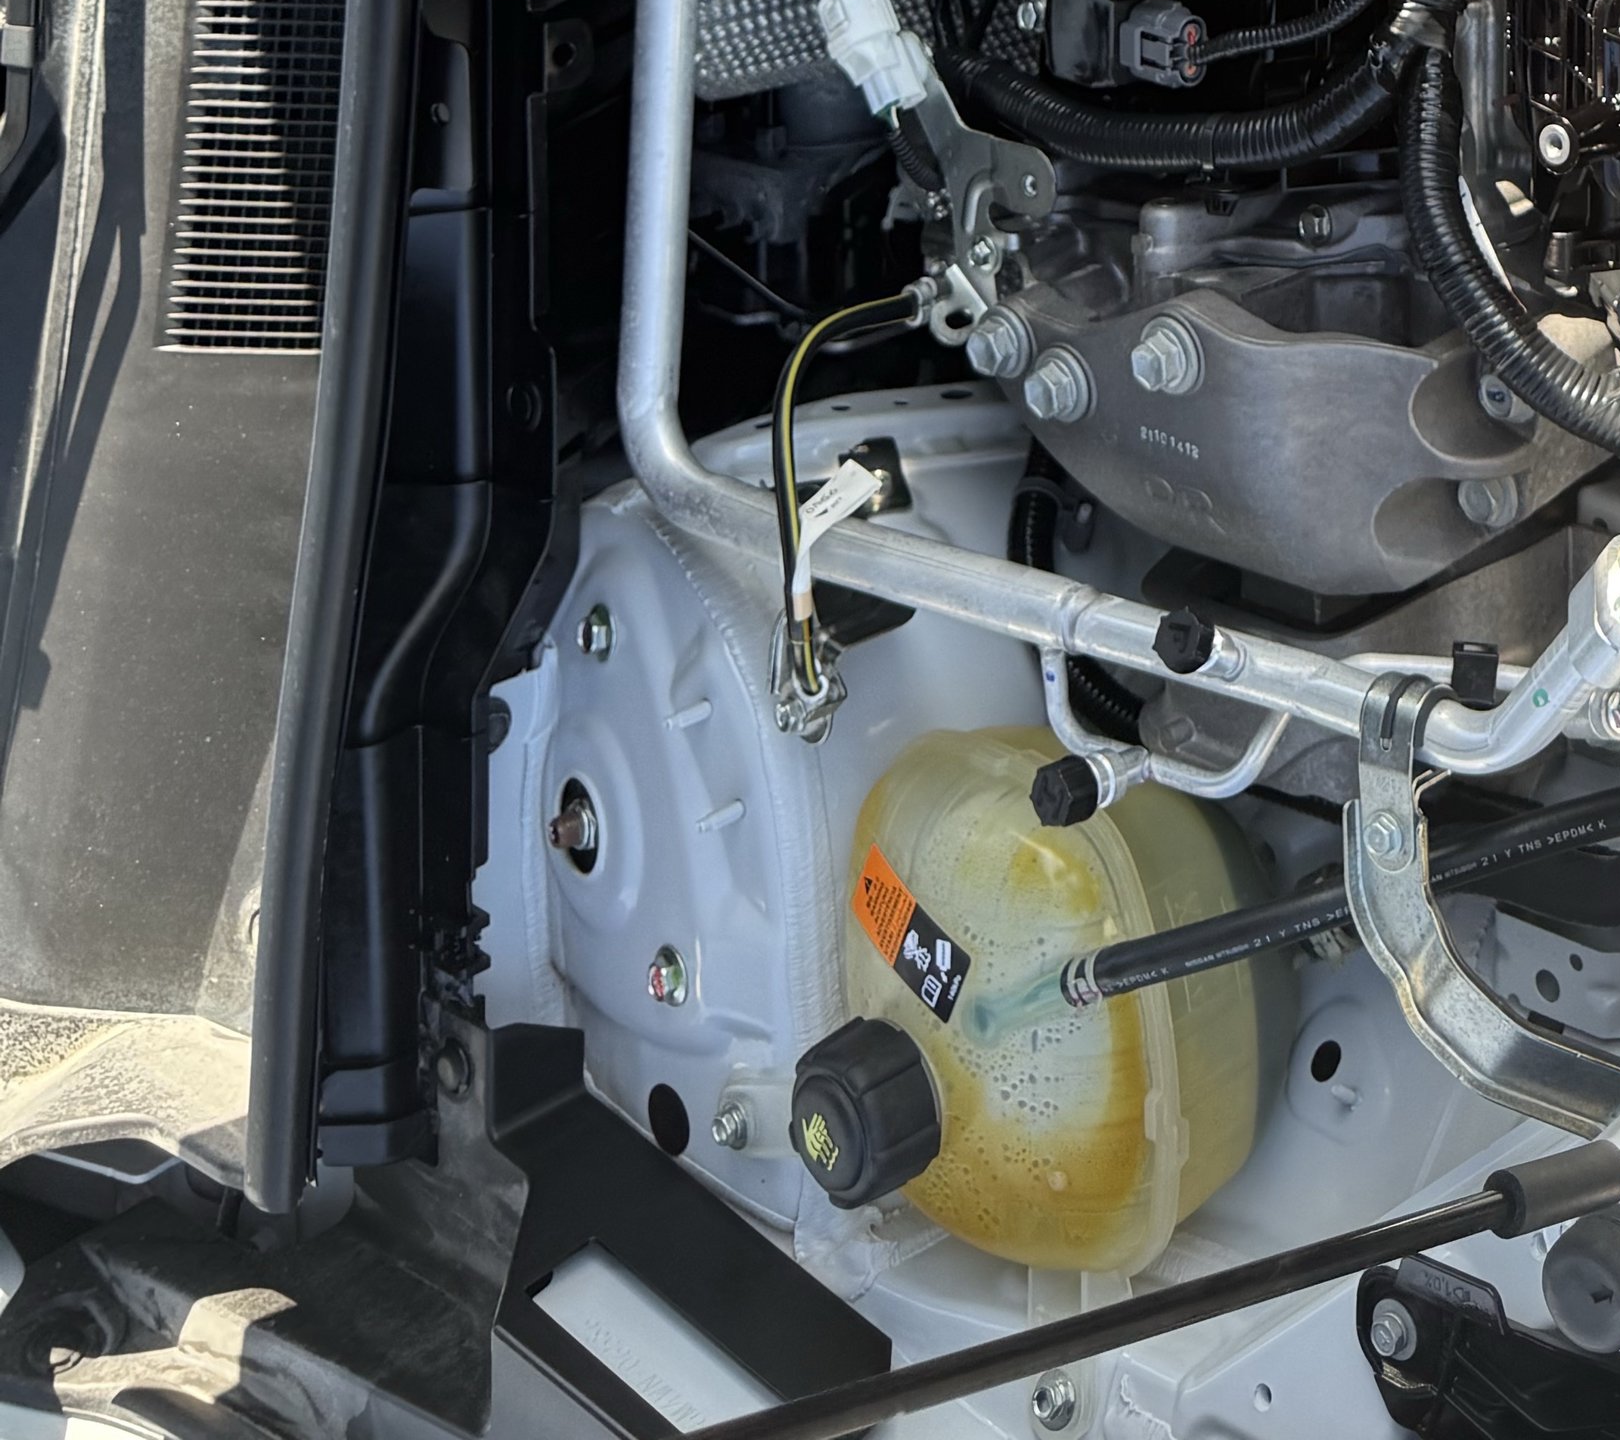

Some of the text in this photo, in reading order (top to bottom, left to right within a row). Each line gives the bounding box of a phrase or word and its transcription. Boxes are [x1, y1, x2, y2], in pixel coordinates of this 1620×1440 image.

[1504, 848, 1512, 859] Y
[1517, 839, 1542, 855] TNS
[1597, 818, 1607, 830] K
[1278, 928, 1287, 938] Y
[1293, 917, 1321, 933] TNS
